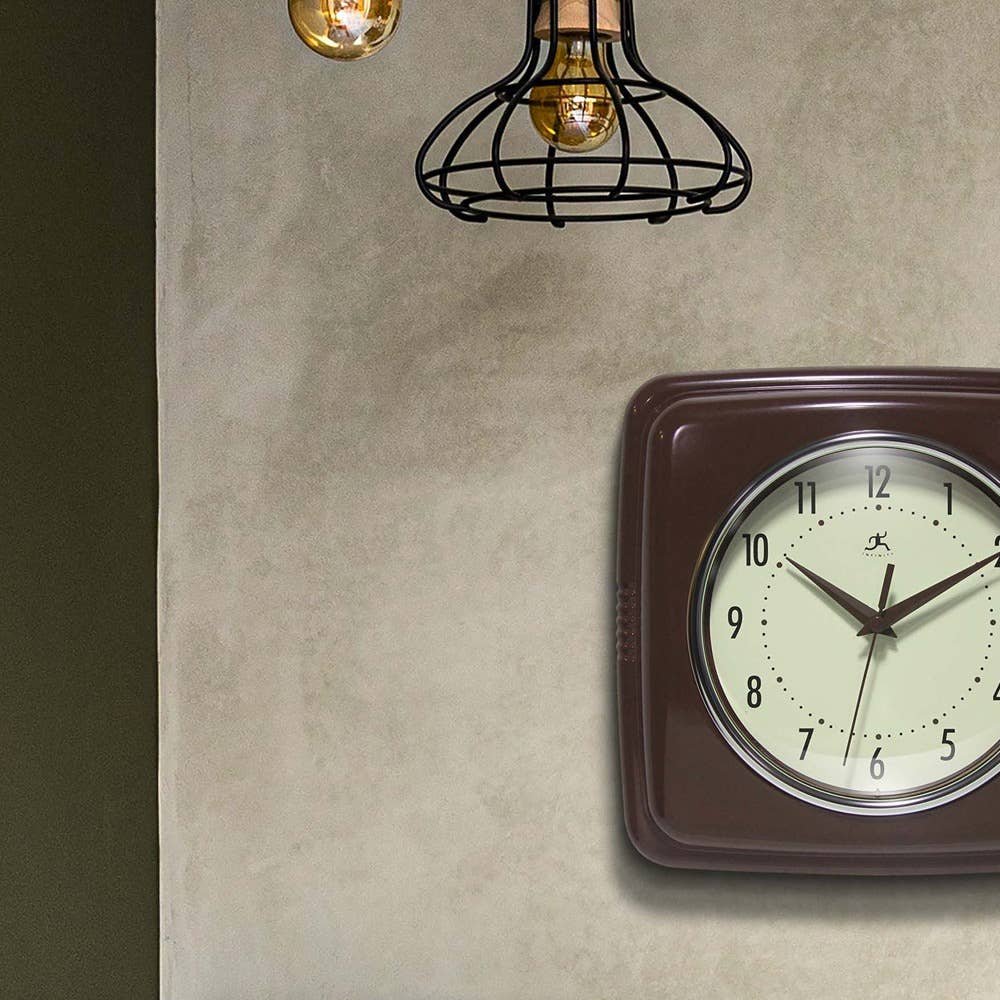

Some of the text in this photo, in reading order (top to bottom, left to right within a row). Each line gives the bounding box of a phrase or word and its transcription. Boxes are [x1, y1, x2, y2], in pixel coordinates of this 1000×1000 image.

[865, 465, 890, 498] 12
[794, 482, 816, 514] 11
[943, 483, 953, 515] 1
[742, 533, 768, 566] 10
[727, 606, 743, 639] 9
[747, 676, 762, 708] 8
[799, 728, 814, 760] 7
[941, 729, 956, 761] 5
[870, 747, 885, 780] 6
